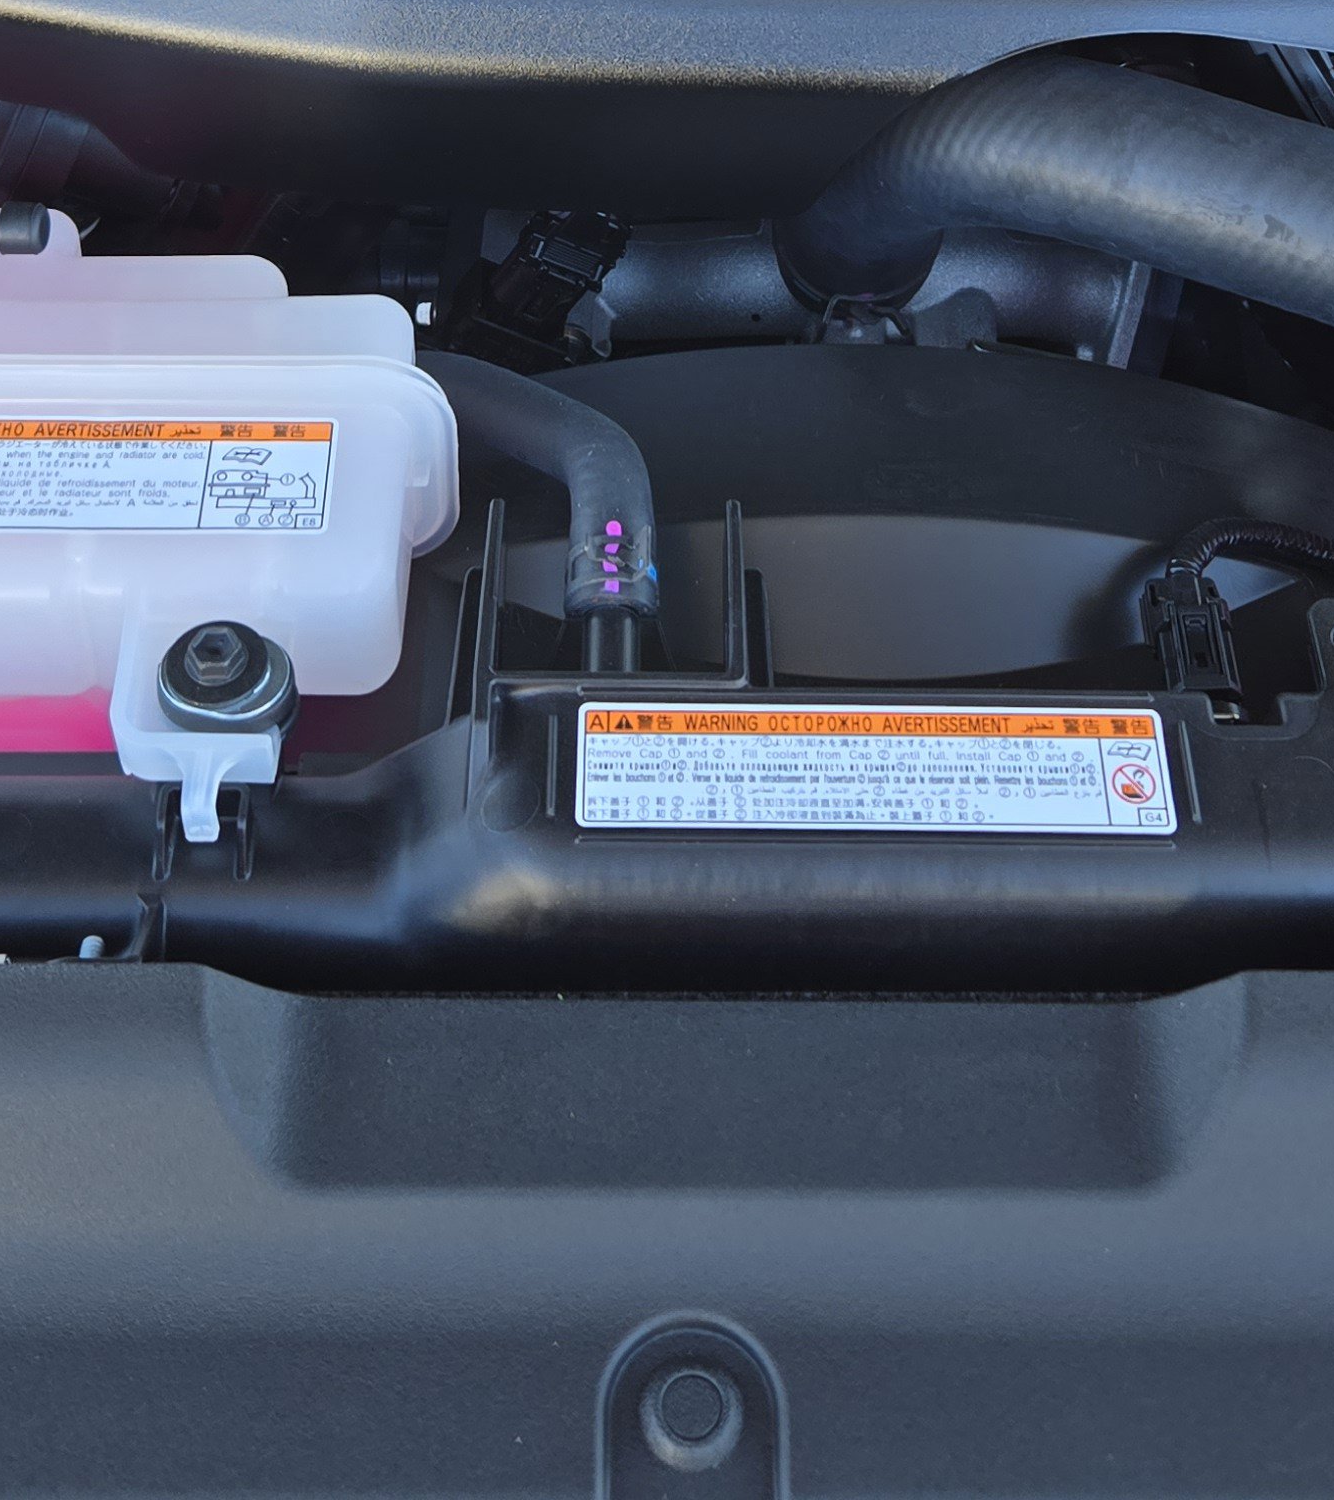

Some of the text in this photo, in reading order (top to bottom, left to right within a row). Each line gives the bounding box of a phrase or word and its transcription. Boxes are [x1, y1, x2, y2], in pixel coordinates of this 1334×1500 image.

[34, 423, 165, 437] AVERTISSEMENT
[5, 450, 31, 458] when
[36, 450, 52, 458] the
[55, 451, 90, 461] engine
[95, 451, 114, 461] and
[119, 450, 156, 459] radiator
[161, 451, 177, 459] are
[182, 450, 206, 461] cold.
[37, 479, 51, 489] de
[57, 479, 135, 489] refroidissement
[140, 479, 156, 489] du
[162, 479, 200, 489] moteur.
[21, 488, 32, 497] et
[38, 488, 48, 497] le
[54, 489, 101, 497] radiateur
[108, 489, 134, 499] sont
[137, 489, 170, 498] froids.
[589, 714, 604, 730] A
[637, 715, 673, 730] 警告
[684, 714, 759, 731] WARNING
[769, 715, 872, 732] ОСТОРОЖНО
[882, 716, 1011, 733] AVERTISSEMENT
[1063, 718, 1099, 735] 警告
[1111, 718, 1148, 735] 警告
[587, 748, 631, 758] Remove
[639, 748, 662, 759] Cap
[686, 749, 707, 761] and
[742, 748, 757, 758] Fill
[766, 750, 808, 759] coolant
[816, 750, 841, 760] from
[849, 749, 872, 760] Cap
[895, 750, 920, 762] until
[928, 750, 948, 760] full.
[955, 751, 990, 761] Install
[998, 750, 1021, 762] Cap
[1044, 752, 1066, 762] and
[1145, 813, 1163, 822] G4
